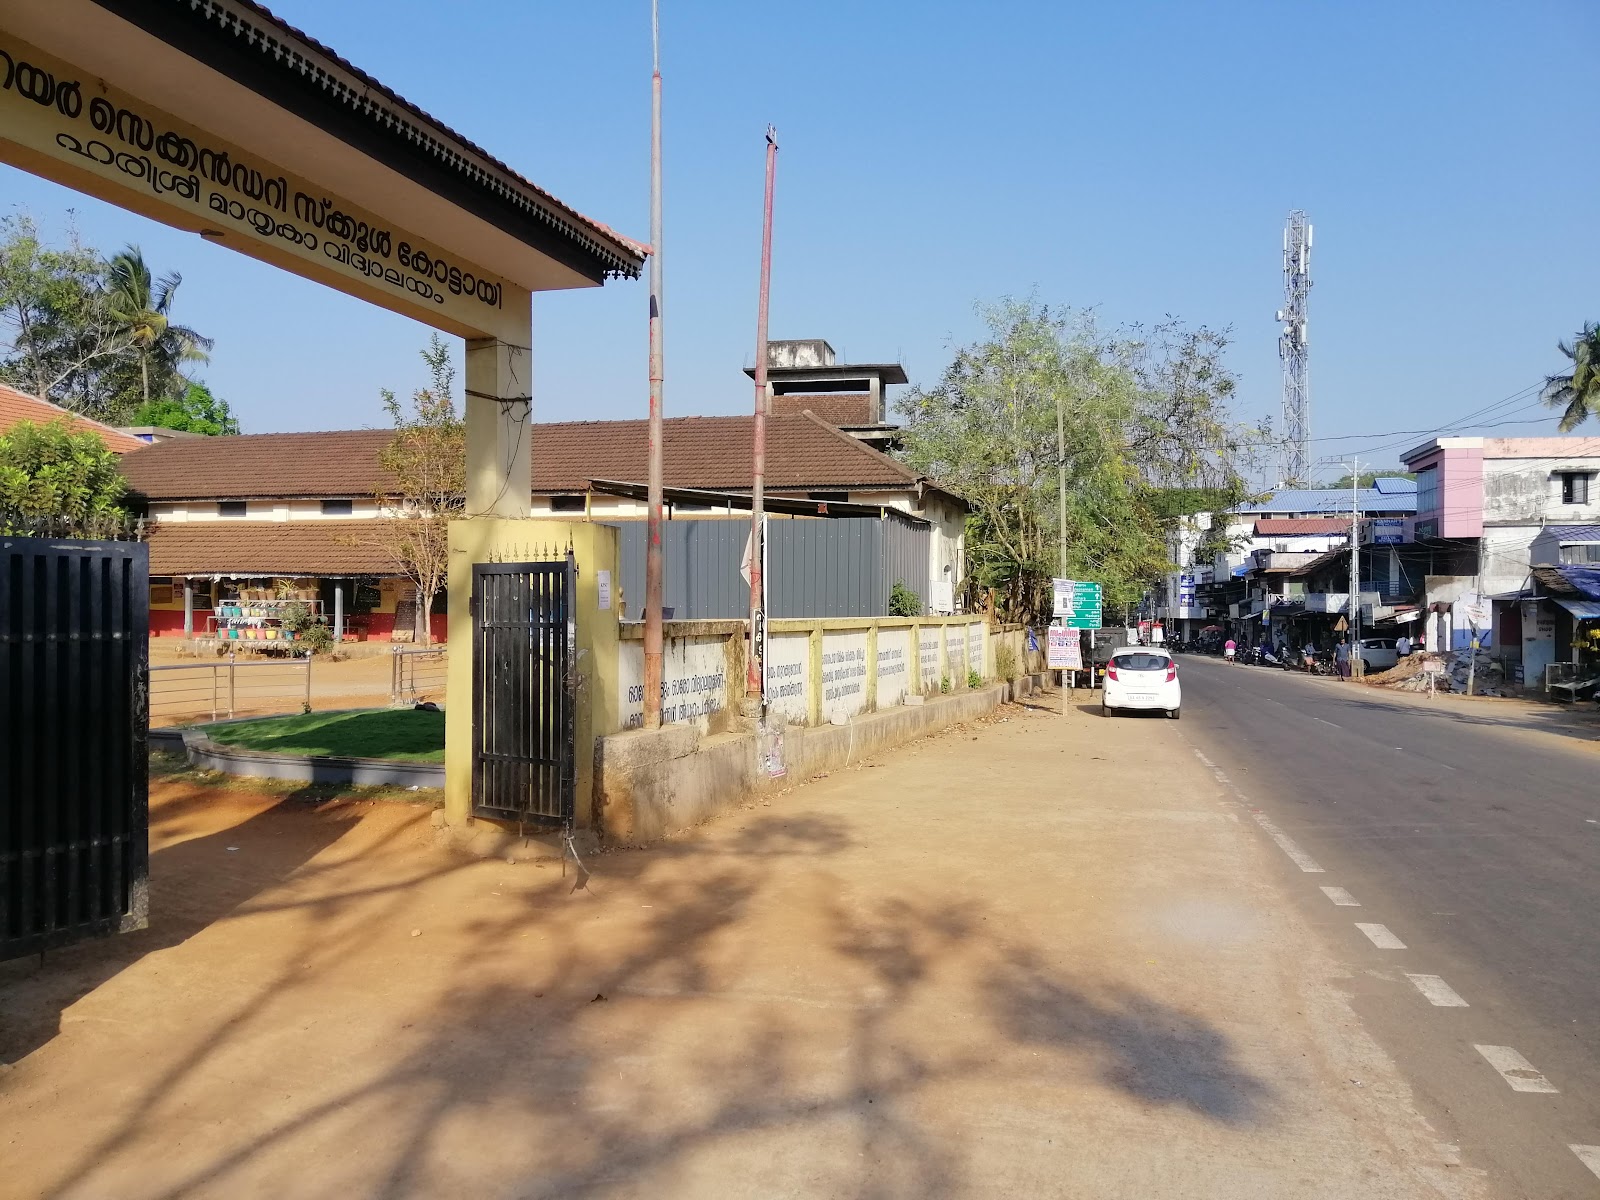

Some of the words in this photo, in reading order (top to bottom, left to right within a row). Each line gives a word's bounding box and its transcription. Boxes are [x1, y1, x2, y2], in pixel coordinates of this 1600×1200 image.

[55, 132, 201, 203] ഹരിശ്രീ
[208, 192, 319, 252] മാതൃകാ
[323, 239, 445, 305] വിദ്യാലയം
[90, 97, 288, 213] സെക്കൻഡറി
[397, 241, 502, 310] കോട്ടായി
